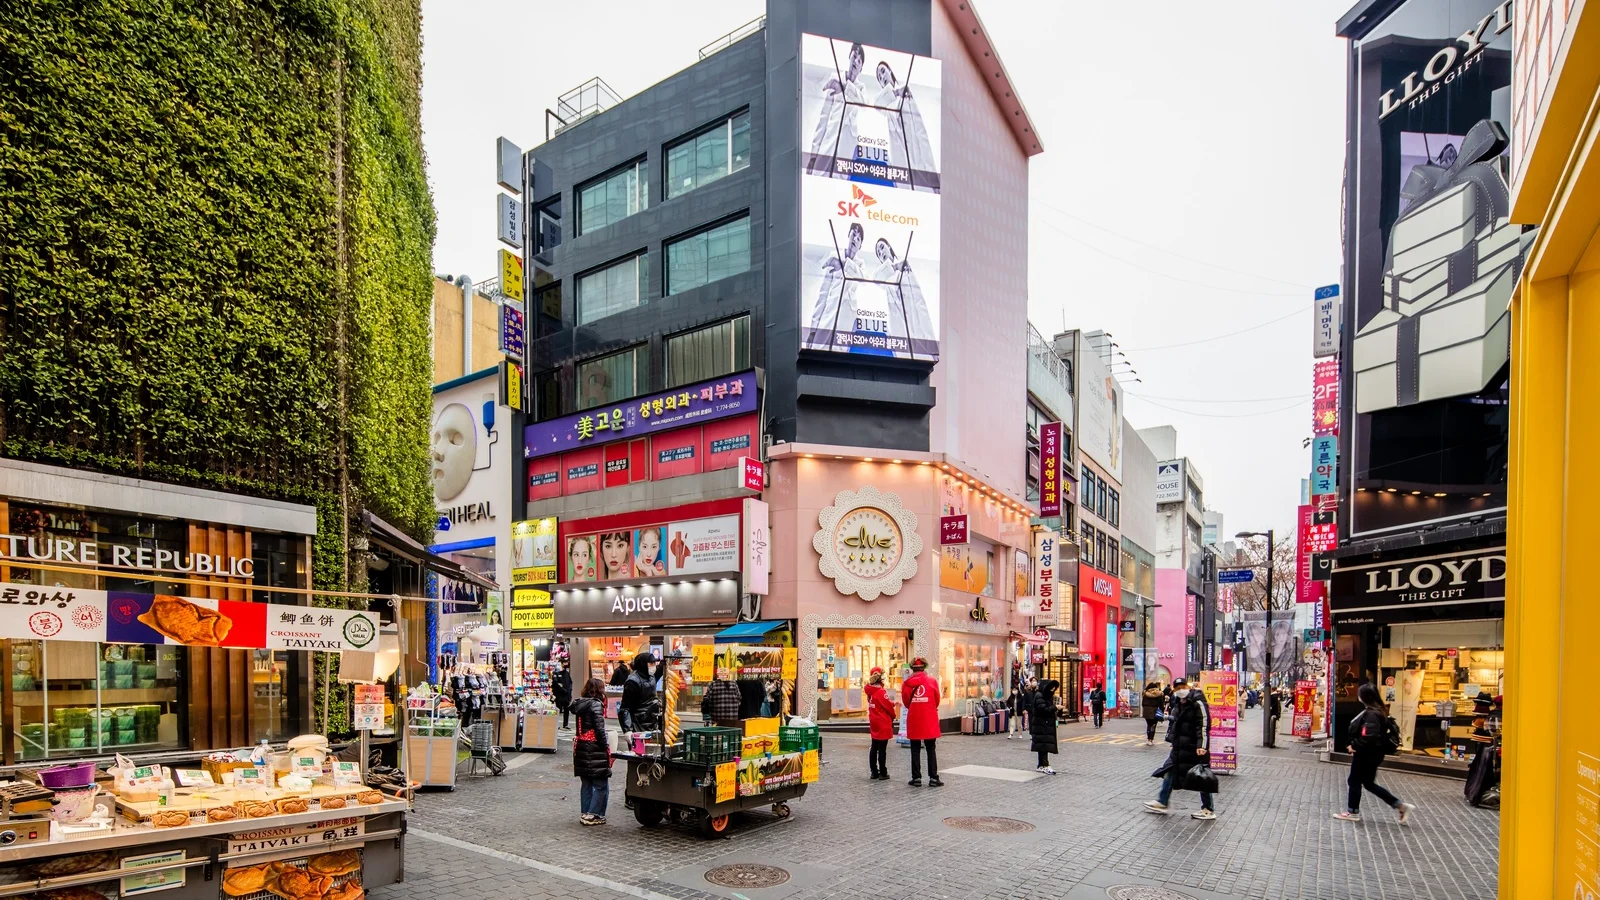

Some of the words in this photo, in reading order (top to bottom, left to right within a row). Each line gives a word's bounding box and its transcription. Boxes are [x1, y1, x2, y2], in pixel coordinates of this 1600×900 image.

[1409, 82, 1441, 110] THE
[1444, 50, 1485, 84] GIFT
[857, 135, 876, 145] Galaxy
[857, 145, 888, 162] BLUE
[837, 201, 859, 218] SK
[867, 209, 918, 226] telecom
[856, 308, 875, 318] Galaxy
[1320, 302, 1332, 340] 백명기
[856, 318, 888, 333] BLUE
[1315, 382, 1337, 400] 2F
[746, 464, 762, 477] キラ星
[1318, 440, 1332, 490] 푸른약국
[943, 520, 965, 530] キラ星
[112, 544, 255, 577] REPUBLIC
[513, 573, 528, 582] TOURIST
[528, 570, 537, 581] 50%
[537, 570, 547, 580] SALE
[1366, 556, 1506, 593] LLOYD
[1093, 576, 1113, 598] MISSHA
[1399, 592, 1427, 602] THE
[1430, 588, 1466, 599] GIFT
[514, 612, 531, 621] FOOT
[536, 611, 554, 620] BODY
[270, 630, 322, 639] CROISSANT
[283, 639, 342, 649] TAIYAKI
[1205, 684, 1225, 706] 足
[1577, 760, 1596, 785] Opening
[233, 826, 294, 840] CROISSANT
[233, 834, 310, 852] TAIYAKI
